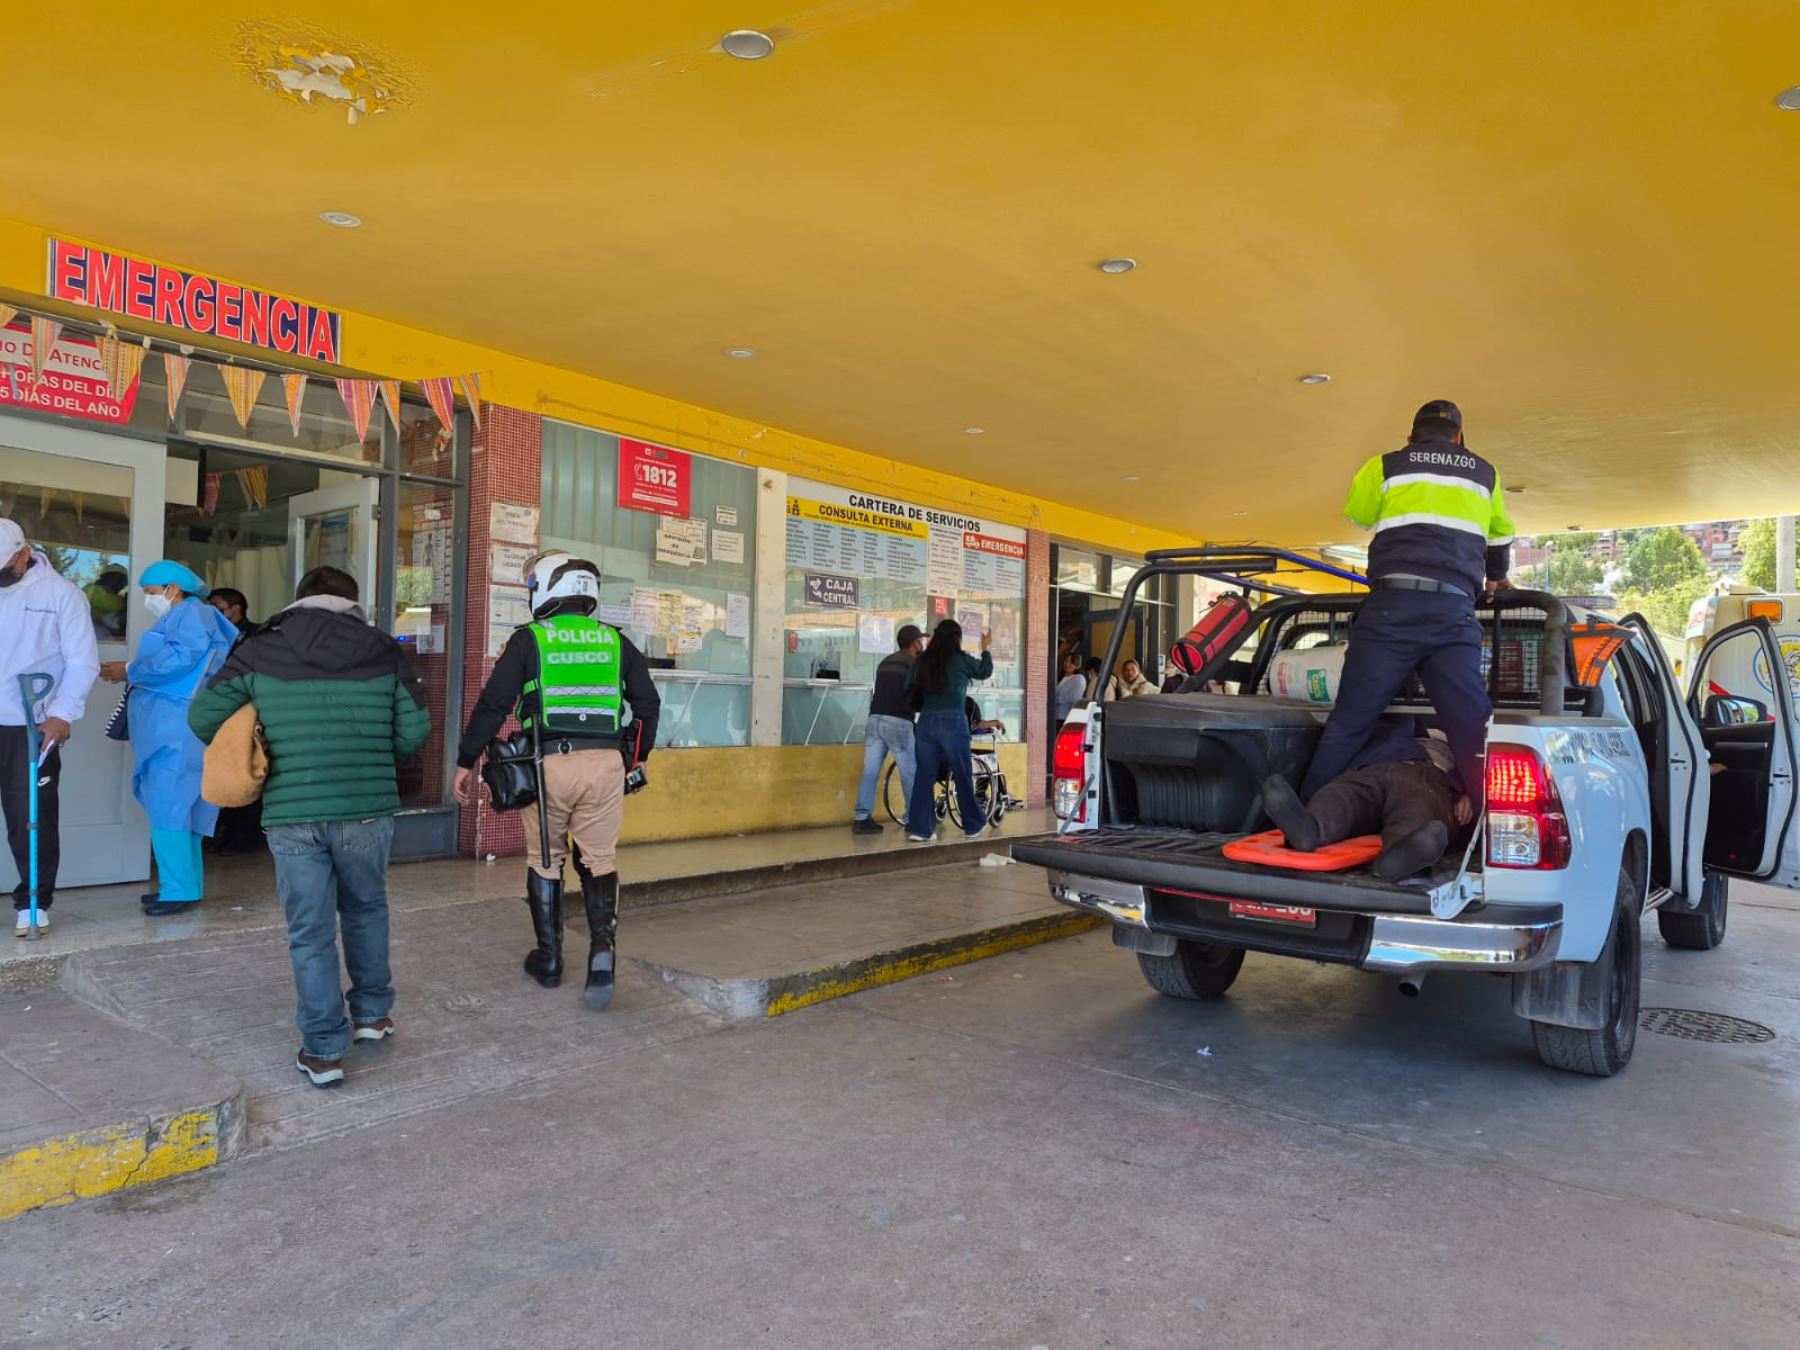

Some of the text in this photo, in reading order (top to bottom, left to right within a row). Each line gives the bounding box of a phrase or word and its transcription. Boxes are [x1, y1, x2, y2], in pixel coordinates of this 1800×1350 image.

[54, 239, 336, 363] EMERGENCIA
[63, 379, 93, 395] DEL
[96, 383, 115, 399] DÍ
[13, 388, 51, 406] DÍAS
[54, 396, 85, 412] DEL
[87, 402, 121, 418] AÑO
[1409, 452, 1477, 470] SERENAZGO
[642, 464, 678, 488] 1812
[819, 504, 914, 532] CONSULTA EXTERNA
[849, 494, 981, 533] CARTERA DE SERVICIOS
[981, 539, 1024, 556] EMERGENCIA
[825, 578, 854, 593] CAJA
[823, 591, 857, 606] CENTRAL
[547, 629, 614, 645] POLICIA
[547, 651, 610, 664] CUSCO
